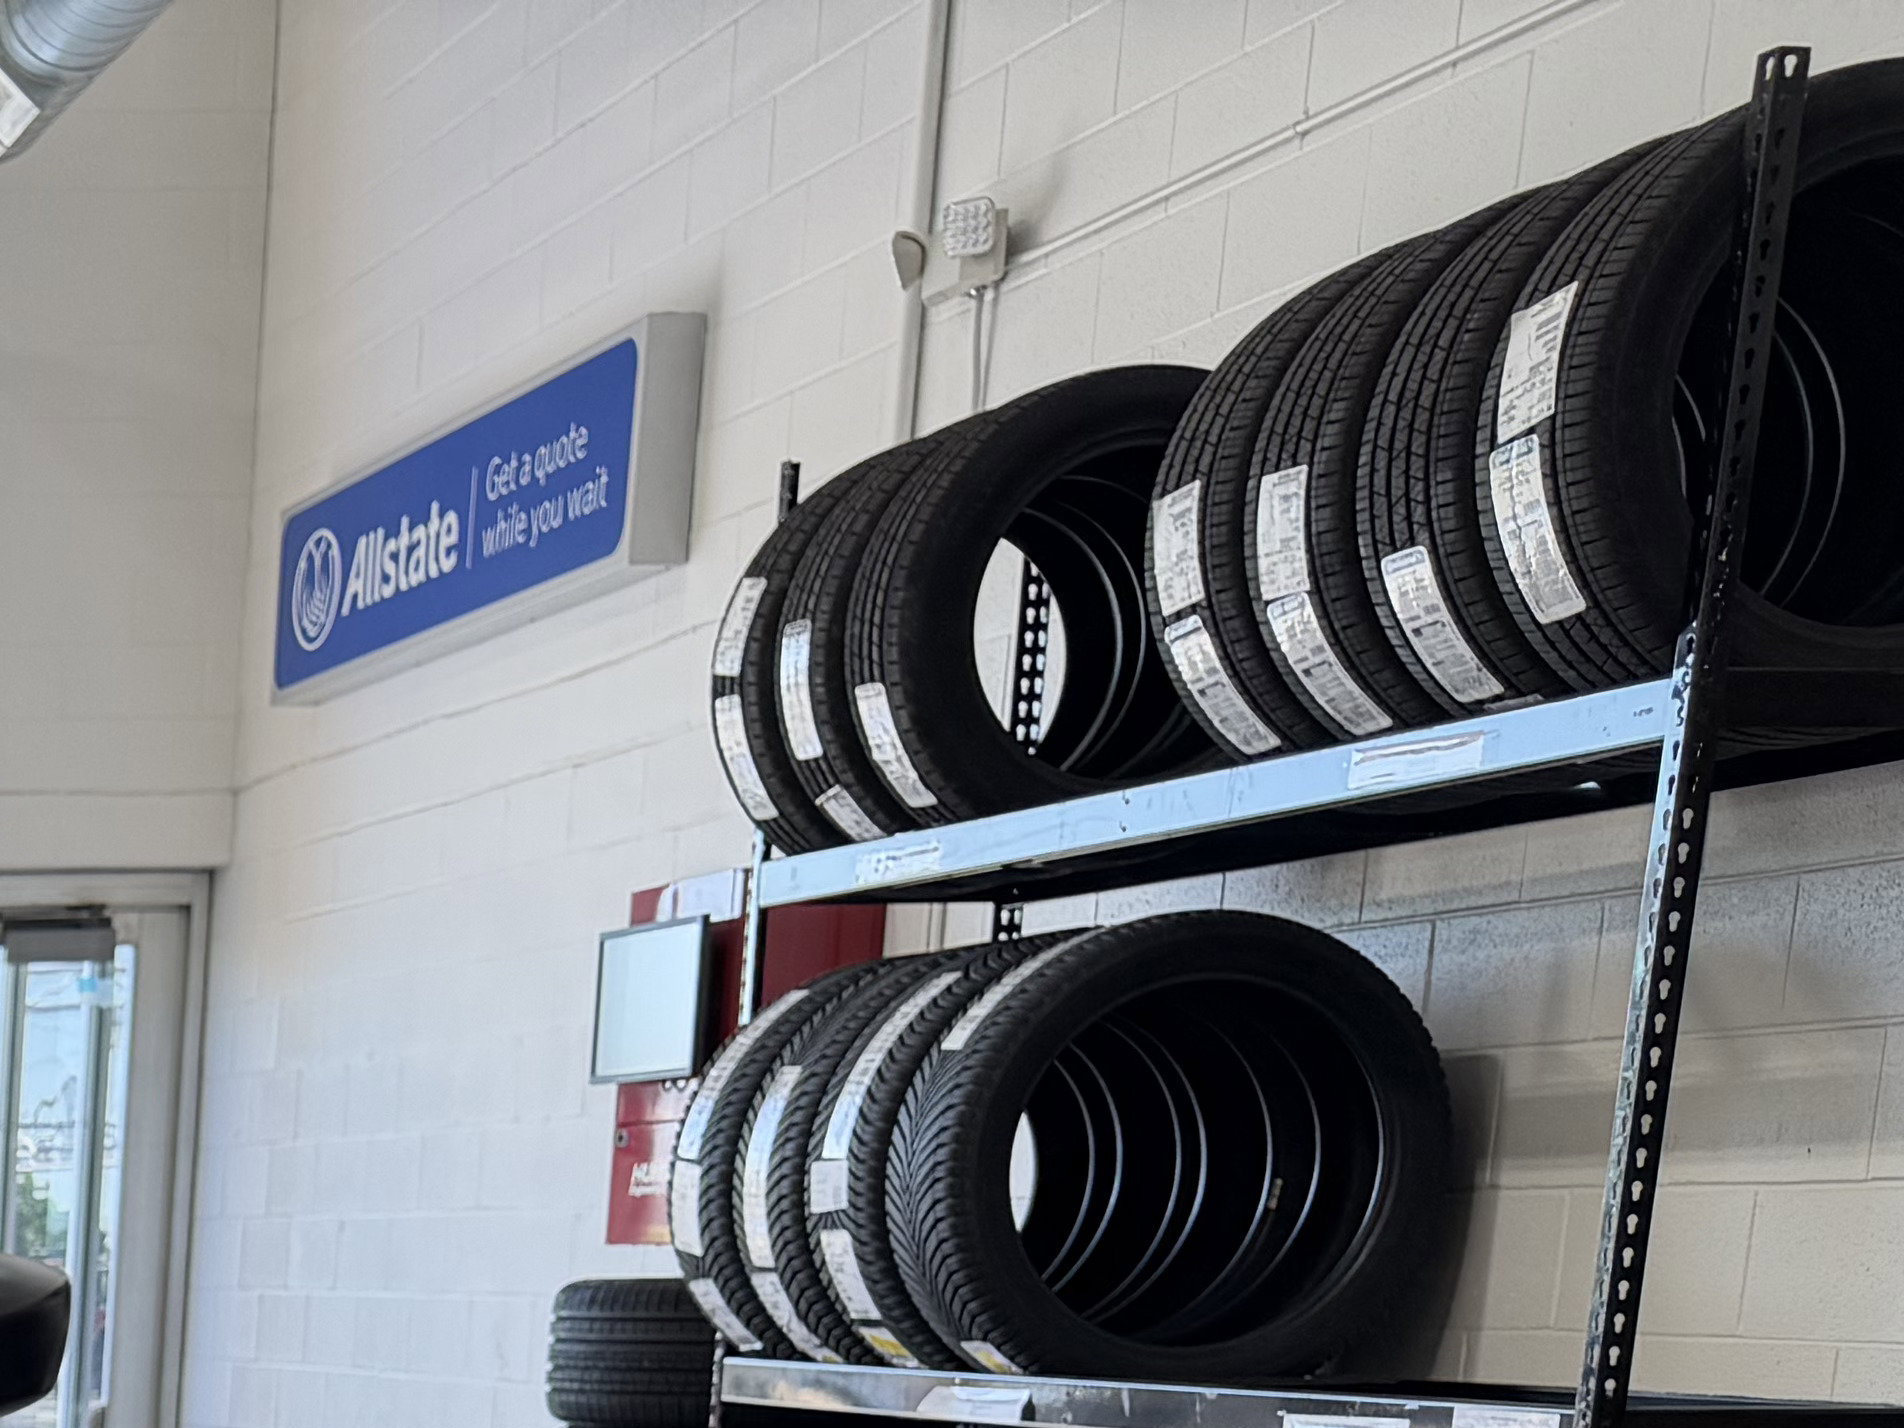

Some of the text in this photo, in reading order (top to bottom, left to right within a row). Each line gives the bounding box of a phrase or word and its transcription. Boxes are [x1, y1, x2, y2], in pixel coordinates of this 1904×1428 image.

[486, 422, 589, 501] Get a quote
[482, 465, 609, 558] while you wait
[340, 500, 460, 617] Allstate
